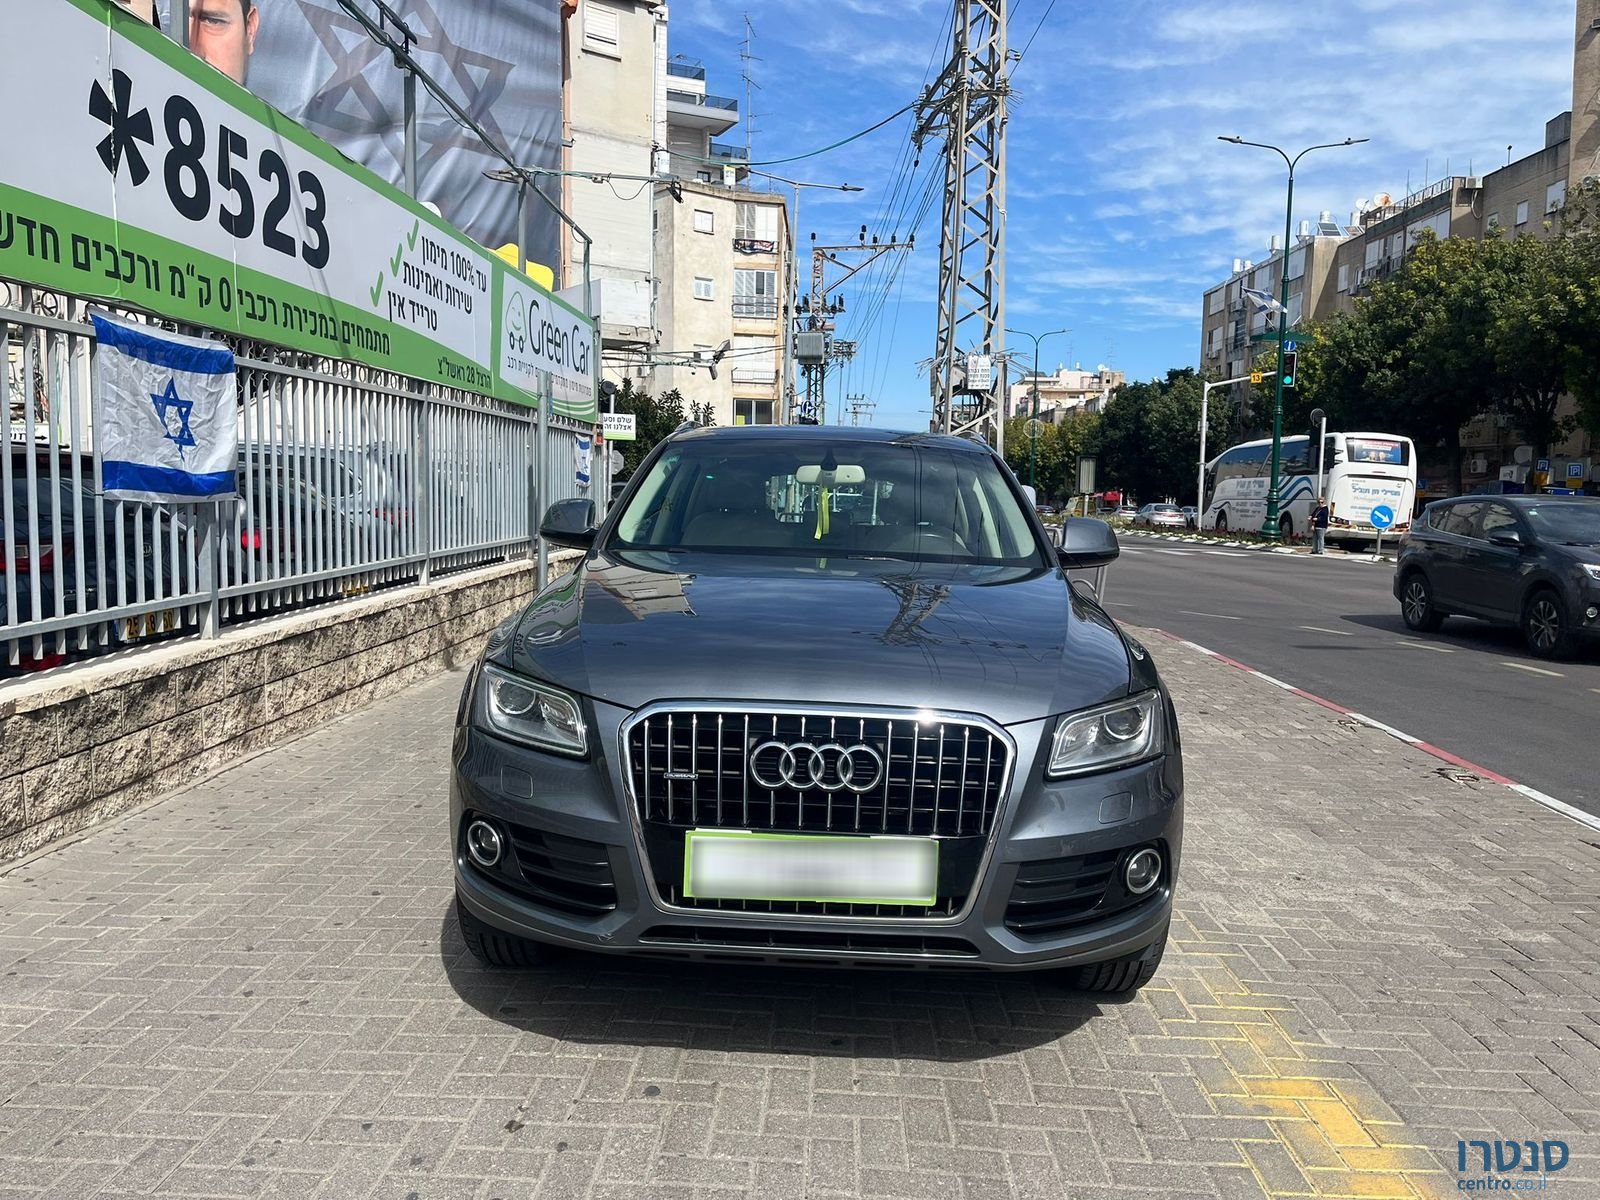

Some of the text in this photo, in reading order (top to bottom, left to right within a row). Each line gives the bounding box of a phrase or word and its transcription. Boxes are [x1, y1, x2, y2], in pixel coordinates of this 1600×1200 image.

[71, 233, 161, 292] ורכבים
[422, 236, 487, 293] עד 100% מימון
[218, 276, 232, 313] 0
[237, 288, 278, 326] רכבי
[403, 260, 472, 314] שירות ואמינות
[283, 302, 338, 341] במכירת
[387, 290, 438, 331] טרייד אין
[341, 320, 390, 355] מתמחים
[529, 299, 590, 376] Green Car
[466, 365, 475, 385] 28
